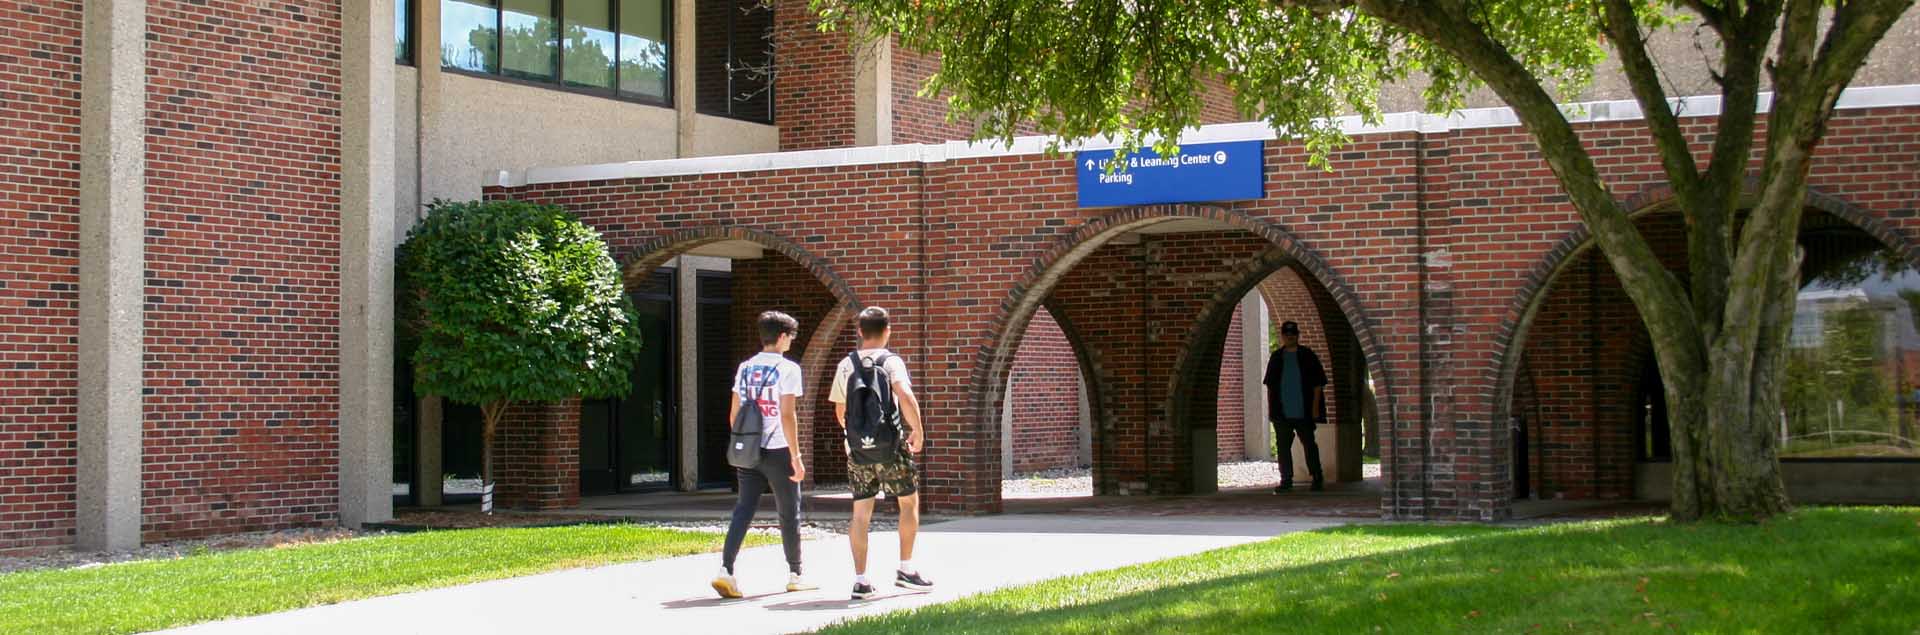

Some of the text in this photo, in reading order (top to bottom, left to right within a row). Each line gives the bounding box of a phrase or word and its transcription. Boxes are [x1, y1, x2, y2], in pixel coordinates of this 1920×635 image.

[1130, 157, 1138, 168] &
[1140, 157, 1179, 168] Learnng
[1181, 154, 1210, 165] Center
[1099, 172, 1132, 184] Parking
